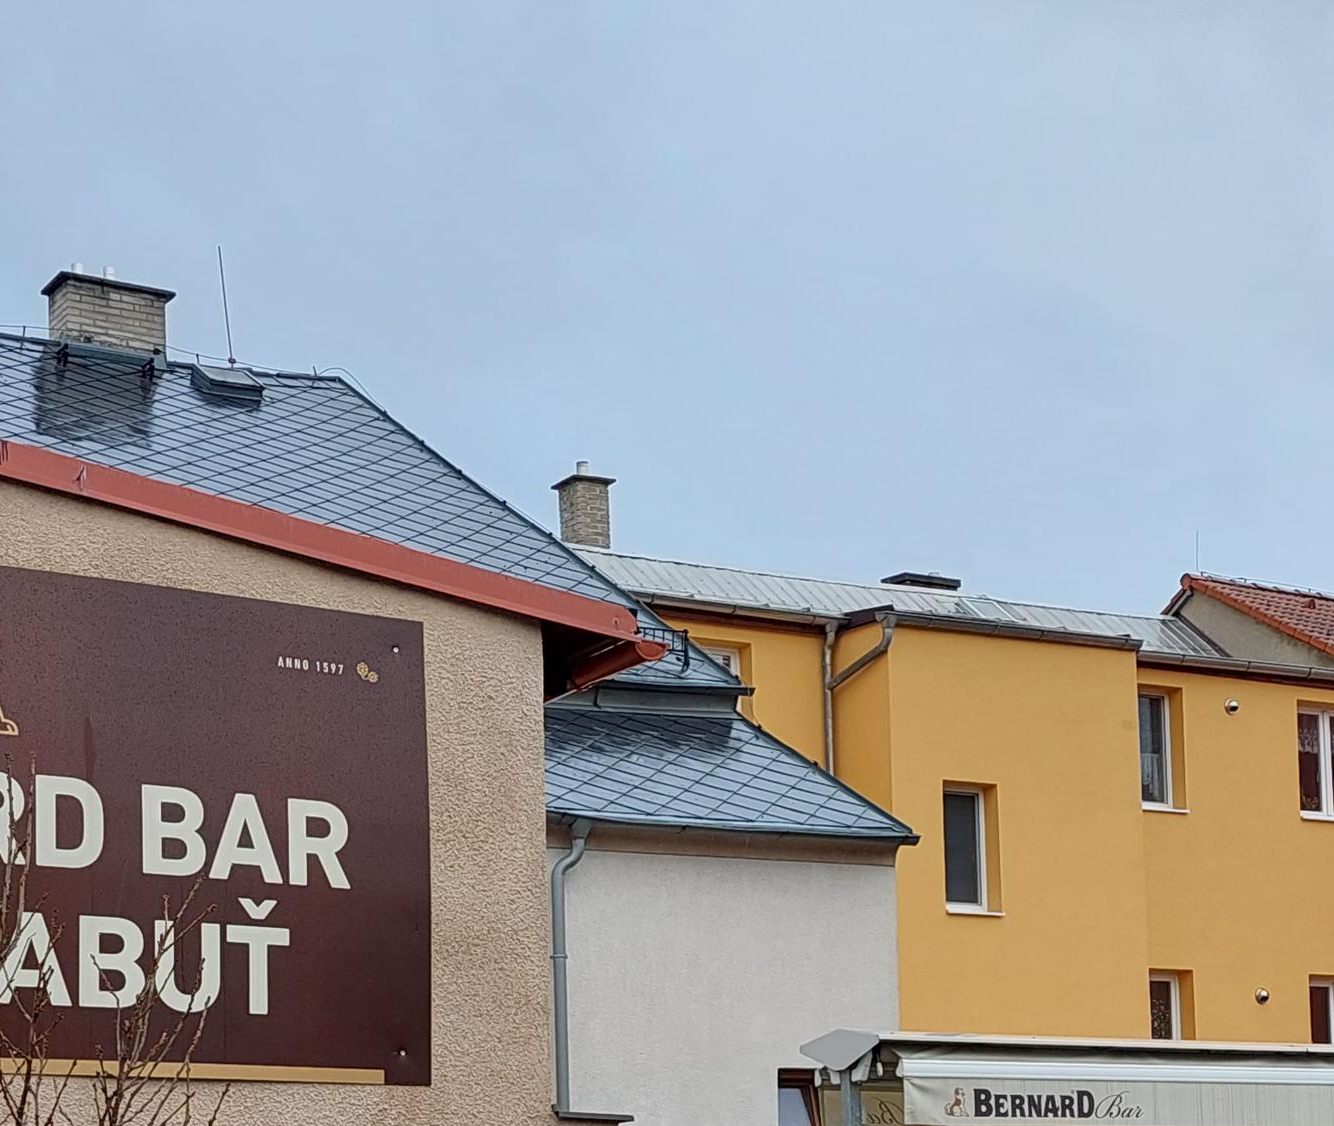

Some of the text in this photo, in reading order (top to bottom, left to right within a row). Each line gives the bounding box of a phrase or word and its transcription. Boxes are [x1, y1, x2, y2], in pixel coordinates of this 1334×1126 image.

[277, 655, 344, 675] ANNO 1597
[141, 784, 351, 890] BAR
[973, 1088, 1144, 1120] BERNARD Bar
